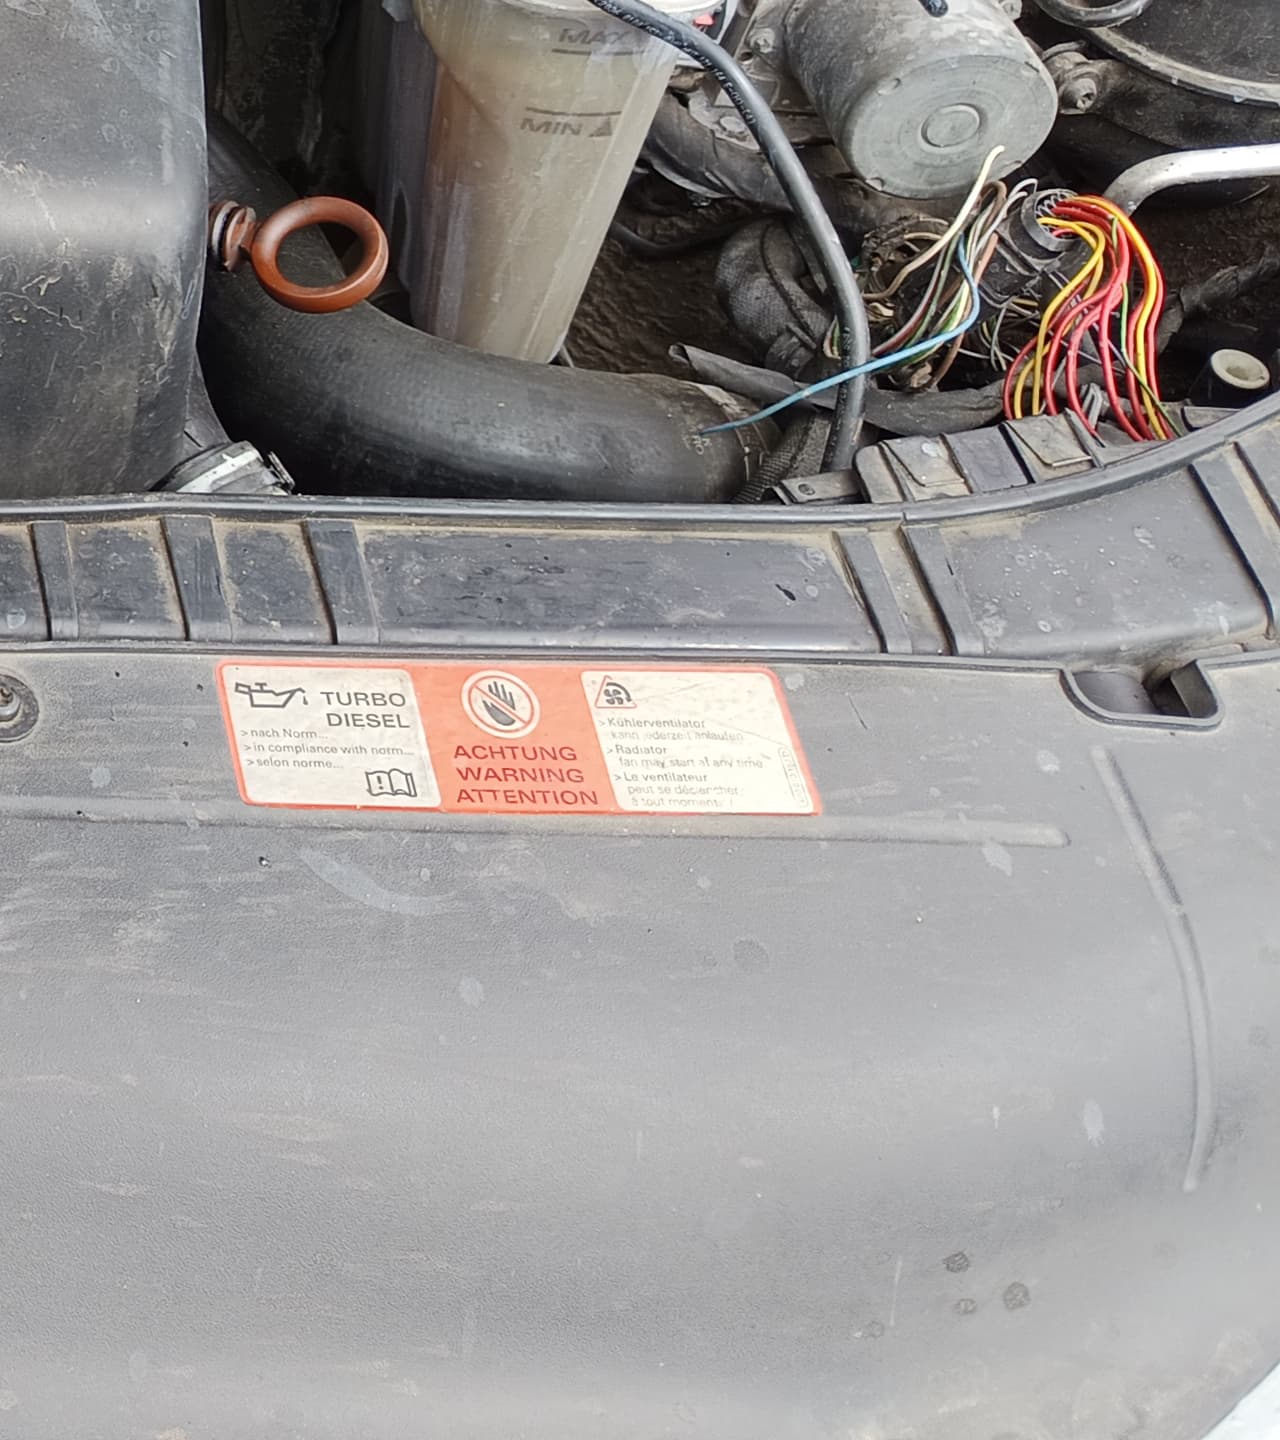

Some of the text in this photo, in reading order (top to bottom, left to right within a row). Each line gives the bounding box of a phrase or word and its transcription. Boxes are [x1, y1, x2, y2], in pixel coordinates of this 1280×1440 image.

[520, 117, 584, 136] MIN
[320, 691, 407, 708] TURBO
[326, 713, 411, 729] DIESEL
[250, 728, 280, 738] nach
[253, 743, 265, 752] in
[268, 743, 338, 756] compliance
[340, 745, 367, 756] with
[454, 745, 578, 761] ACHTUNG
[615, 744, 667, 756] Radiator
[257, 756, 290, 768] selon
[618, 755, 638, 767] fan
[641, 758, 665, 770] may
[712, 759, 733, 770] any
[456, 767, 584, 784] WARNING
[624, 771, 709, 784] Le ventilateur
[457, 789, 599, 806] ATTENTION
